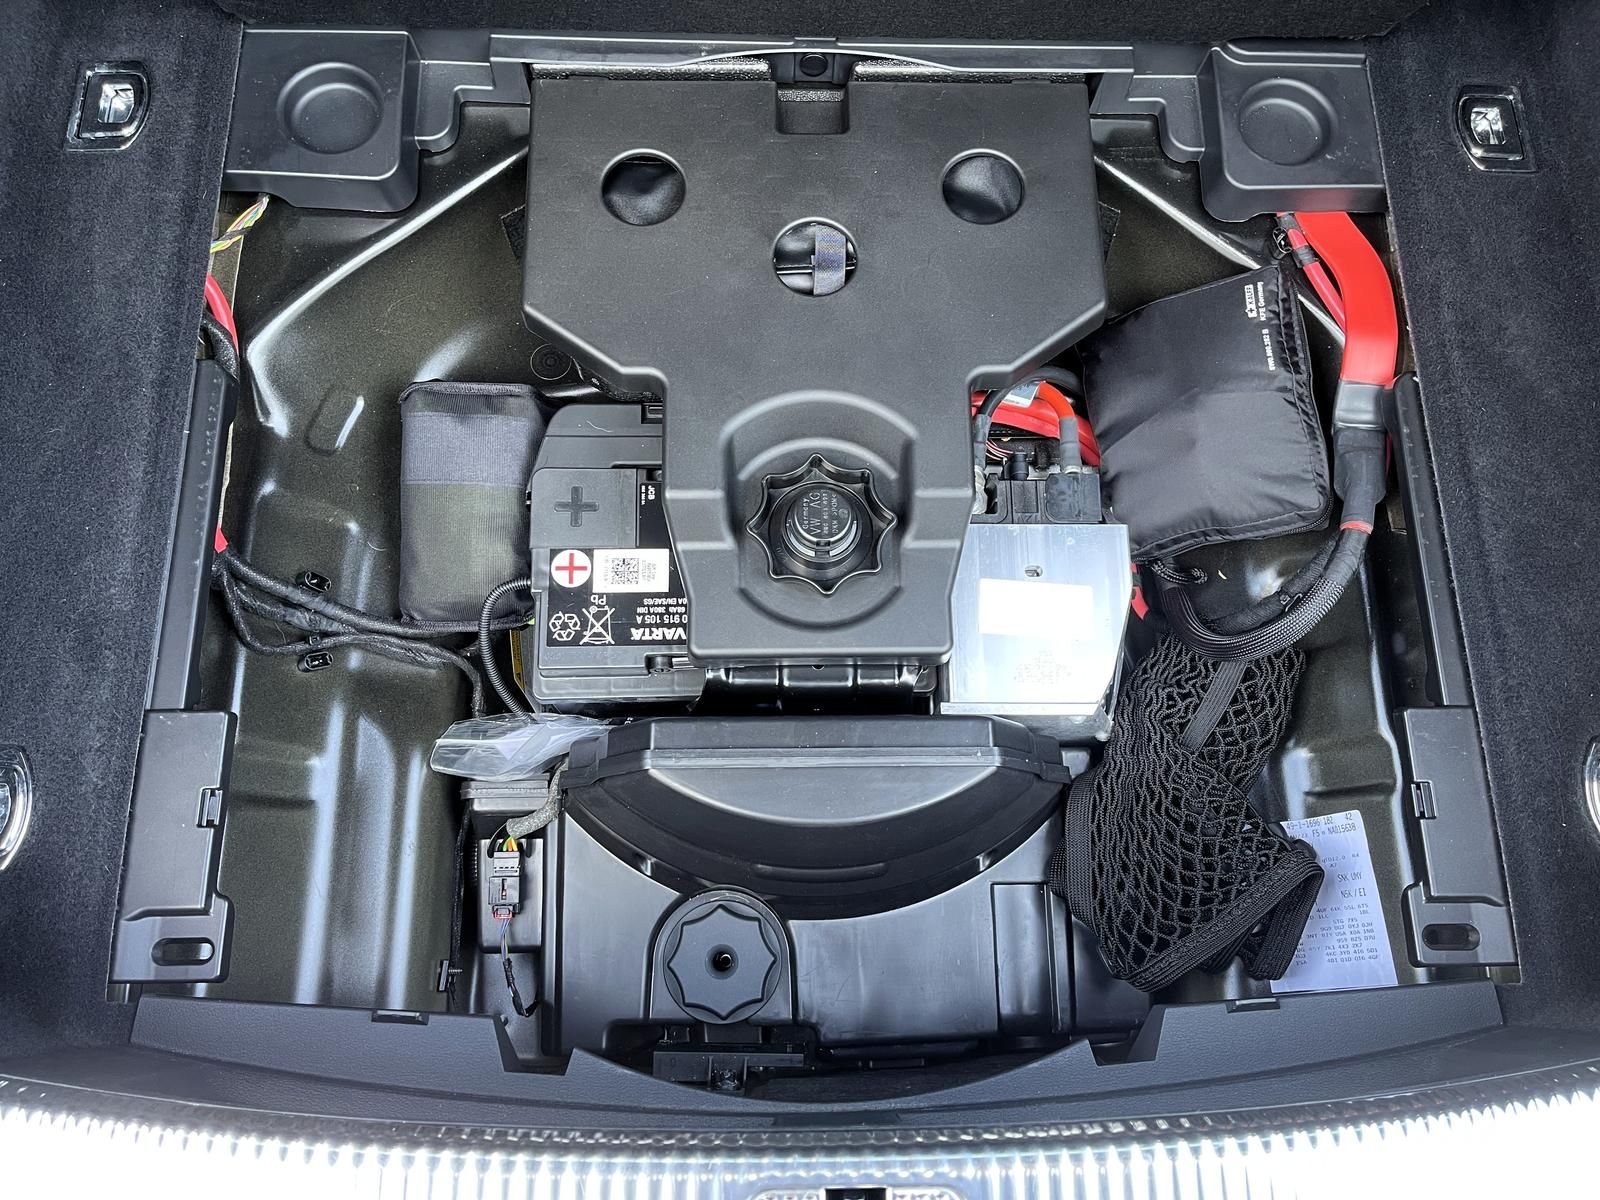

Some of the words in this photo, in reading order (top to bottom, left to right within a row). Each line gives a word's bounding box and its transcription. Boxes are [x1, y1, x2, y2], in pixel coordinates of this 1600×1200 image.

[1257, 282, 1265, 307] Germany
[809, 492, 821, 508] AG
[810, 518, 821, 535] VW
[591, 594, 606, 605] Pb
[636, 615, 642, 623] A
[645, 614, 660, 623] 105
[663, 614, 680, 623] 915
[630, 627, 687, 640] VARTA
[1345, 811, 1353, 821] 42
